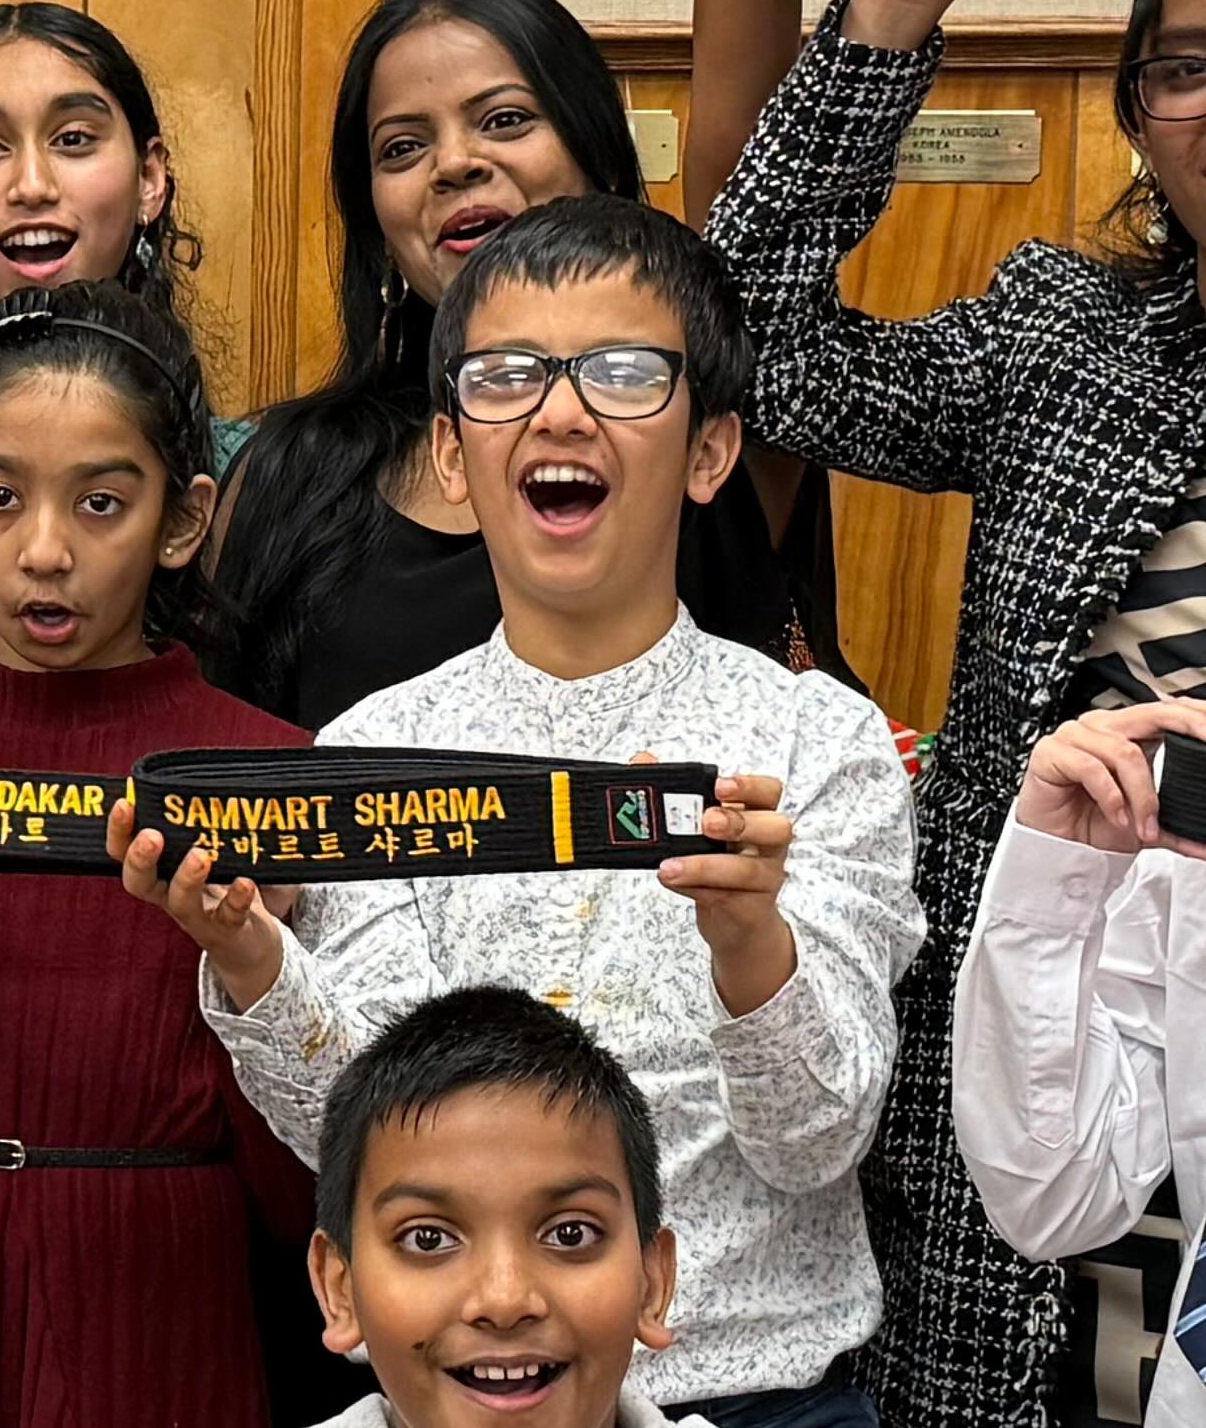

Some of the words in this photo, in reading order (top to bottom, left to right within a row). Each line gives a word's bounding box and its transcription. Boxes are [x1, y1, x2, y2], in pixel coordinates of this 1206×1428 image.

[163, 794, 334, 834] SAMVART
[353, 786, 507, 827] SHARMA
[365, 823, 480, 863] 샤르마
